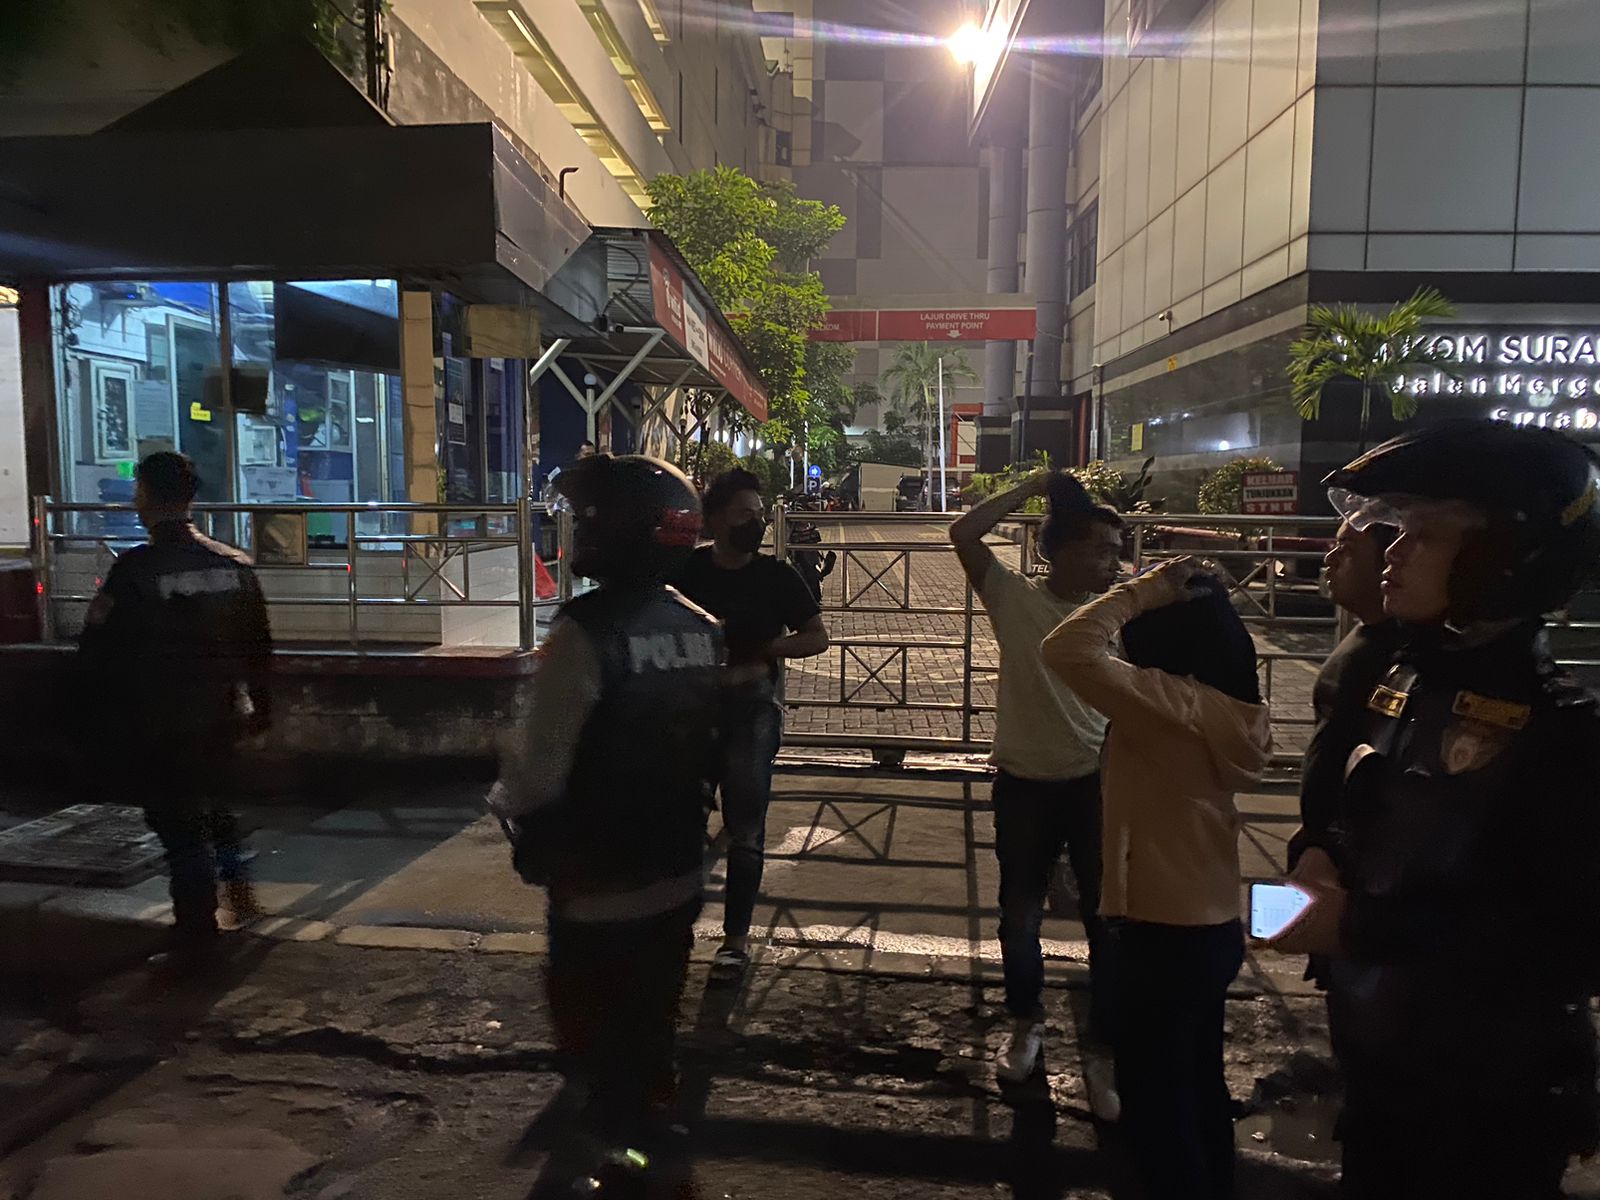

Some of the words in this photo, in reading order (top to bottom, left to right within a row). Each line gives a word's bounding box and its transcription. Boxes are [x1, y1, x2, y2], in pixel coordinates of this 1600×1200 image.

[920, 312, 945, 321] LAJUR
[945, 312, 969, 321] DRIVE
[969, 311, 991, 321] THRU
[926, 322, 961, 330] PAYMENT
[961, 321, 985, 330] POINT
[1499, 334, 1600, 365] SURA
[1489, 407, 1600, 430] Surab
[809, 480, 818, 492] P
